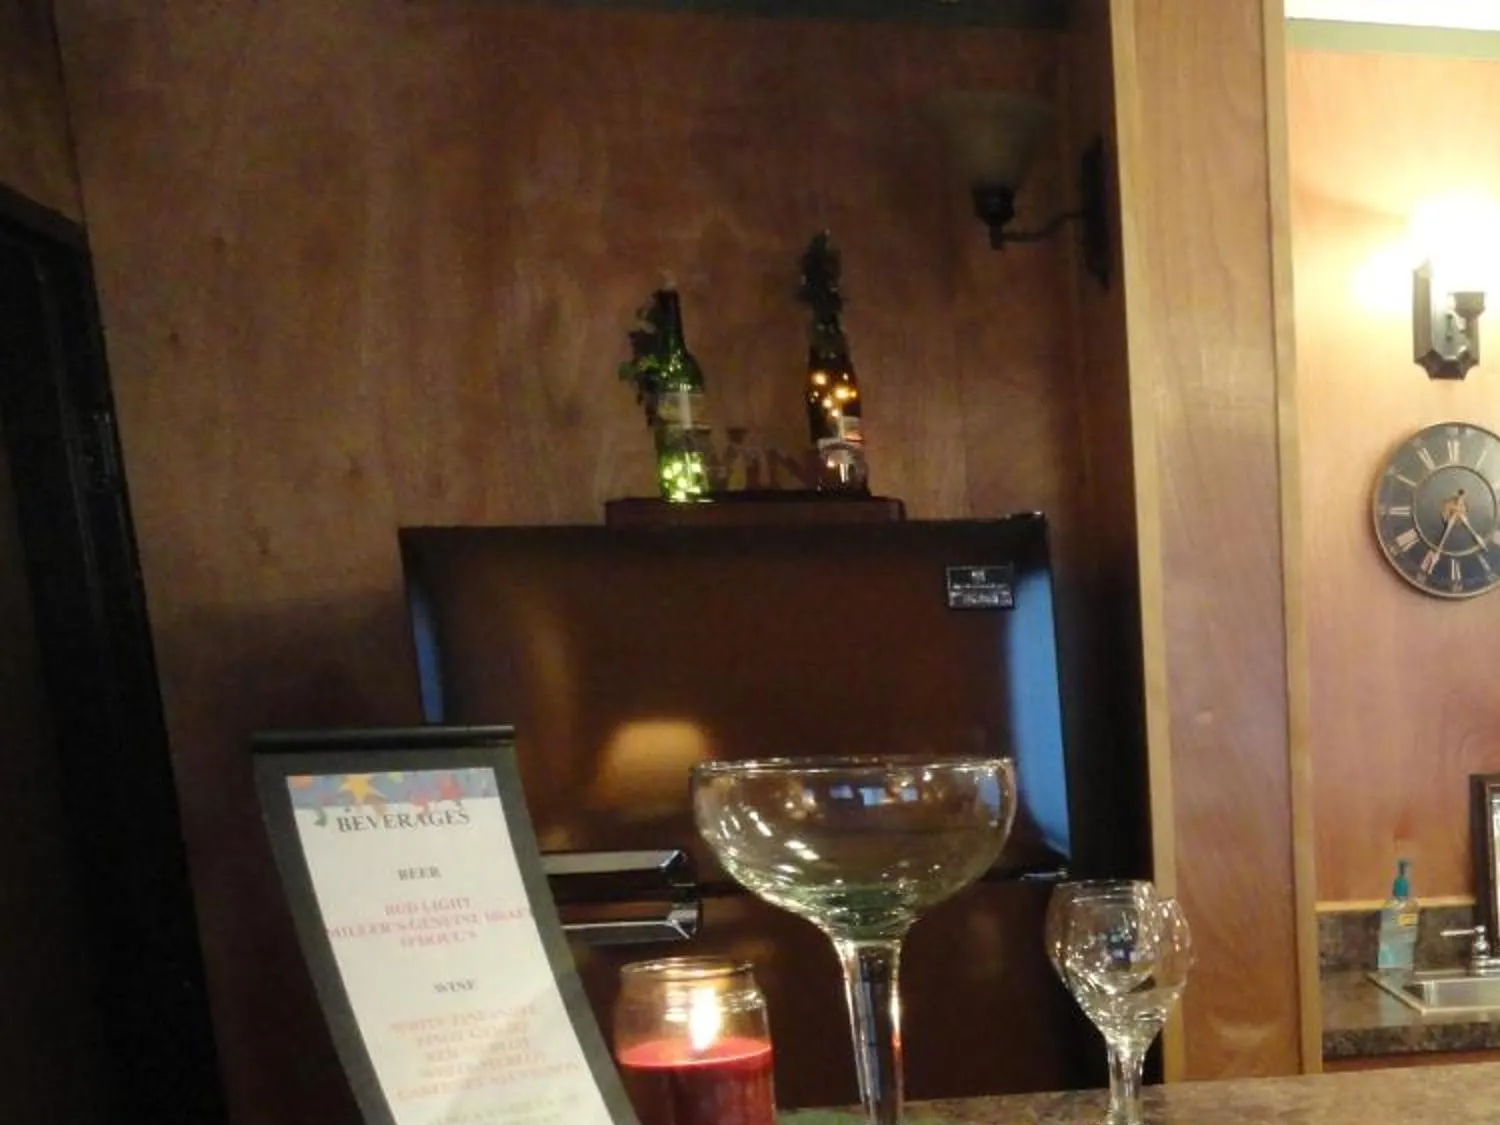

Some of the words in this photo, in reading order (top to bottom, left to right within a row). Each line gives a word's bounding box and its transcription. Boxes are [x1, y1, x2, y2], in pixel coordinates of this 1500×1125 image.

[336, 810, 470, 833] BEVERAGES
[398, 866, 441, 880] BEER
[386, 900, 419, 916] BUD
[422, 897, 472, 912] LIGHT
[433, 979, 476, 993] WINE
